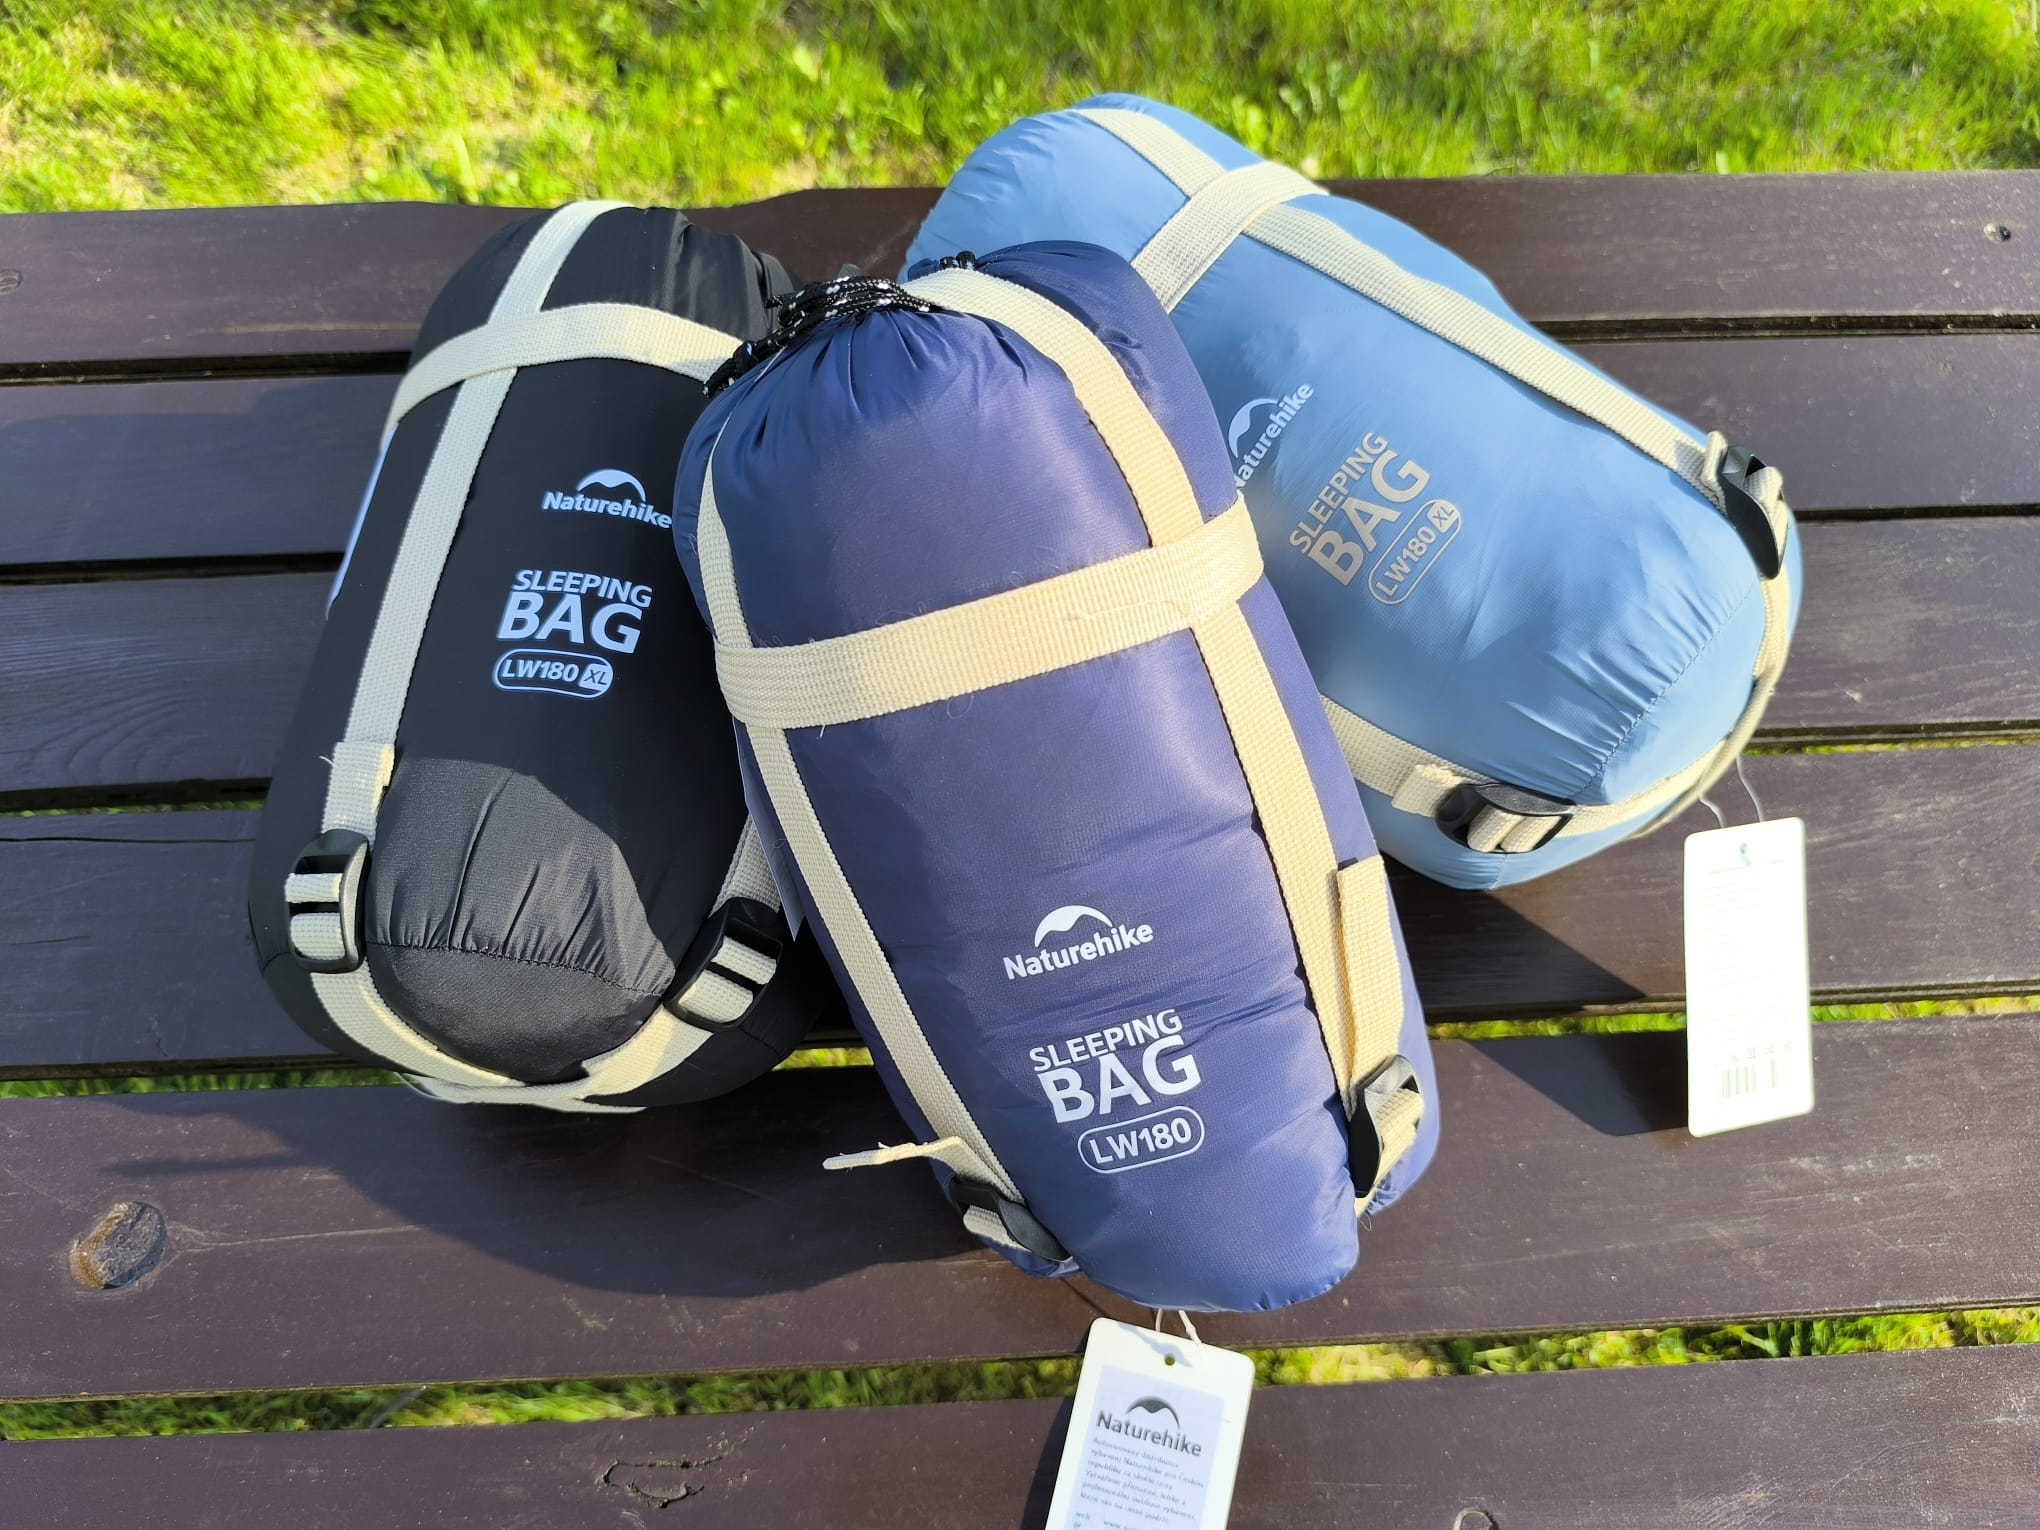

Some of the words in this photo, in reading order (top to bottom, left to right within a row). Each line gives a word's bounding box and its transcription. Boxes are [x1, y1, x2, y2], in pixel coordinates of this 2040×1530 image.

[541, 491, 673, 529] Naturehike
[1289, 432, 1389, 554] SLEEPING
[1308, 449, 1431, 586] BAG
[1375, 526, 1436, 596] LW180
[1432, 505, 1455, 528] XL
[512, 569, 653, 608] SLEEPING
[496, 591, 642, 653] BAG
[502, 659, 579, 682] LW180
[582, 667, 609, 686] XL
[1003, 924, 1153, 980] Naturehike
[1029, 1009, 1183, 1072] SLEEPING
[1037, 1034, 1201, 1123] BAG
[1089, 1117, 1192, 1164] LW180
[1096, 1409, 1202, 1457] Naturehike
